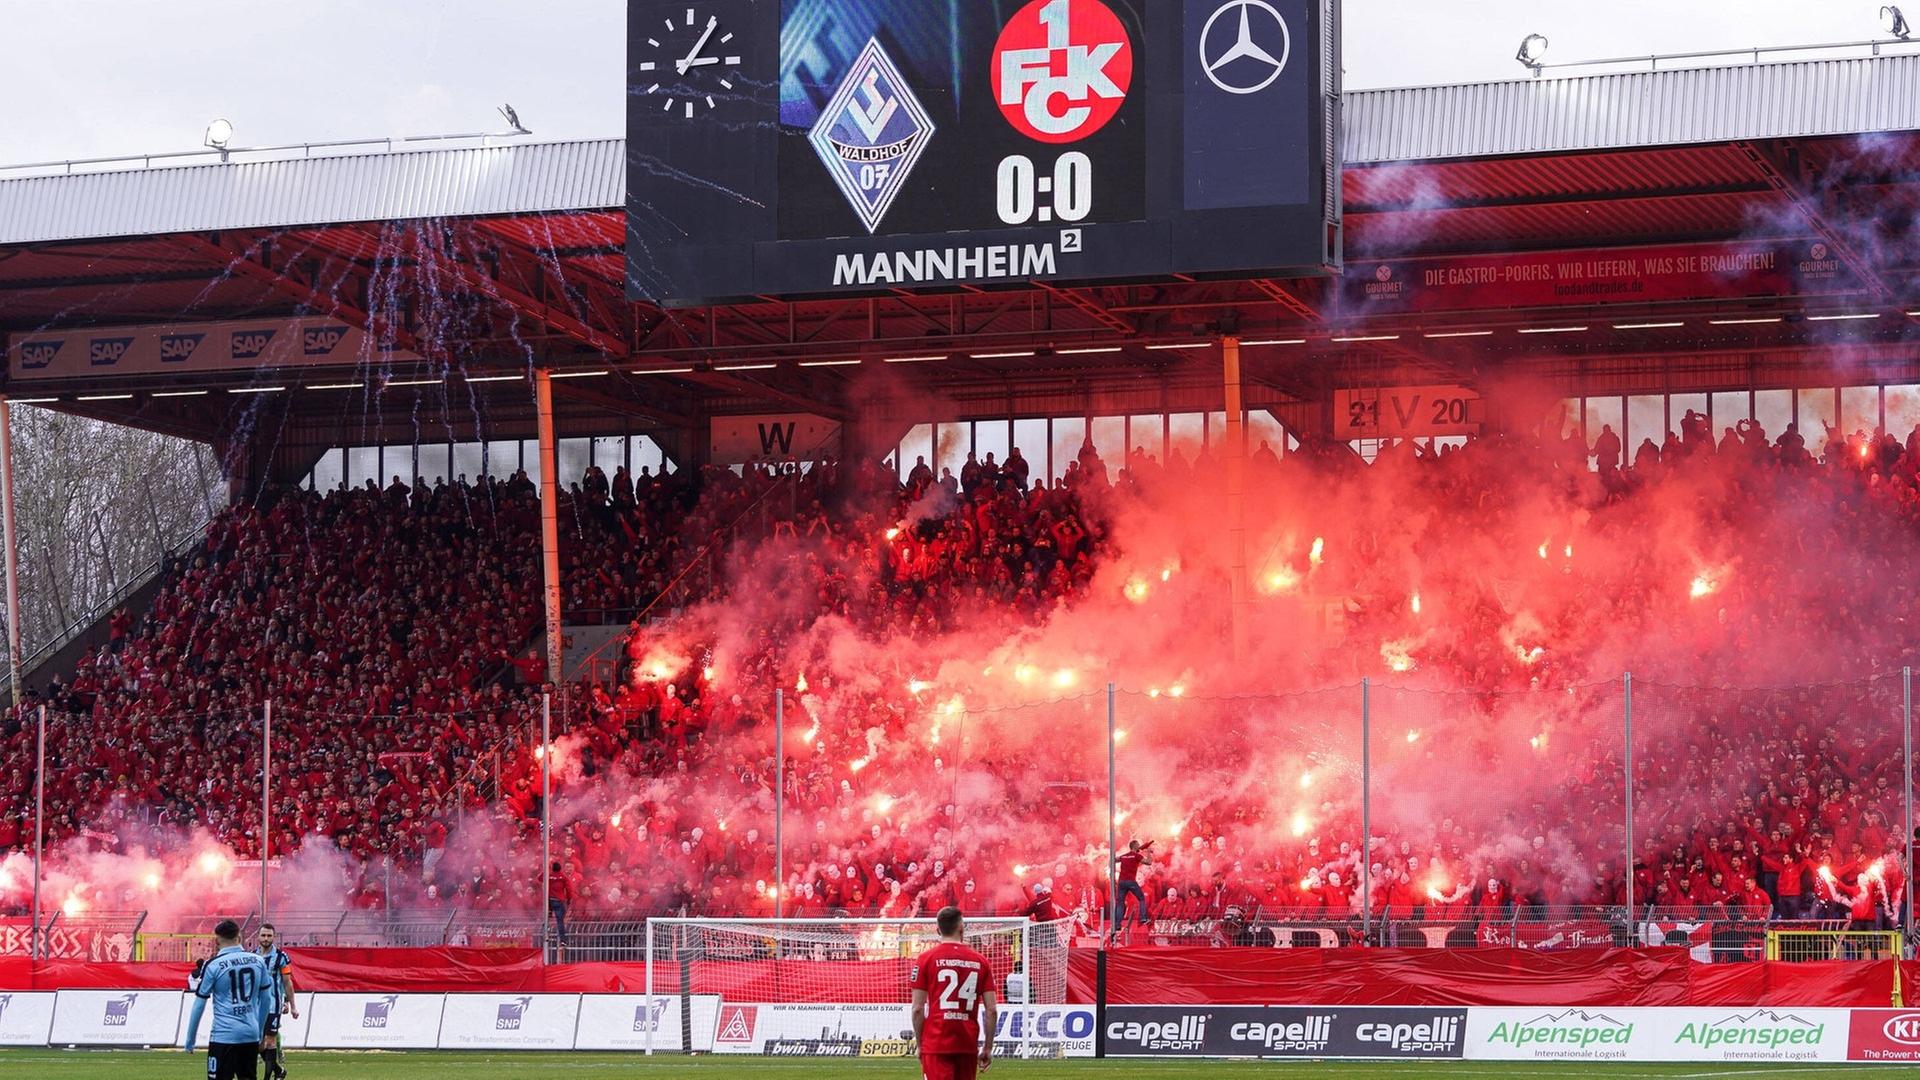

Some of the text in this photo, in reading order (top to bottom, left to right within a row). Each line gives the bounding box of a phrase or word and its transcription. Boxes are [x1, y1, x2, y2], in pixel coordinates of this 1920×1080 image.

[839, 141, 909, 161] WALDHOF
[861, 163, 891, 190] 07
[997, 151, 1092, 225] 0:0
[833, 243, 1057, 286] MANNHEIM
[1425, 252, 1775, 286] DIE GASTRO-PORFIS. WIR LIEFERN, WAS SIE BRAUCHEN!
[1800, 260, 1840, 272] GOURMET
[1365, 281, 1402, 294] GOURMET
[91, 341, 125, 362] SAP
[162, 338, 195, 358] SAP
[233, 334, 267, 355] SAP
[305, 332, 340, 354] SAP
[22, 346, 55, 366] SAP
[1350, 395, 1465, 430] 21 V 20
[758, 422, 796, 455] W
[229, 967, 256, 1004] 10
[938, 969, 978, 1011] 24
[104, 1015, 127, 1025] SNP
[363, 1016, 387, 1027] SNP
[497, 1019, 520, 1030] SNP
[1107, 1016, 1206, 1046] capelli
[1230, 1016, 1331, 1047] capelli
[1356, 1017, 1459, 1049] capelli
[1488, 1022, 1634, 1048] Alpensped
[1675, 1023, 1824, 1049] Alpensped
[773, 1041, 807, 1055] bwin
[817, 1042, 852, 1055] bwin
[1150, 1041, 1203, 1050] SPORT
[1274, 1042, 1328, 1051] SPORT
[1400, 1043, 1455, 1052] SPORT
[1534, 1049, 1627, 1060] Internationale Logistik
[1724, 1050, 1818, 1061] Internationale Logistik
[1863, 1050, 1881, 1059] The
[1882, 1050, 1912, 1059] Power
